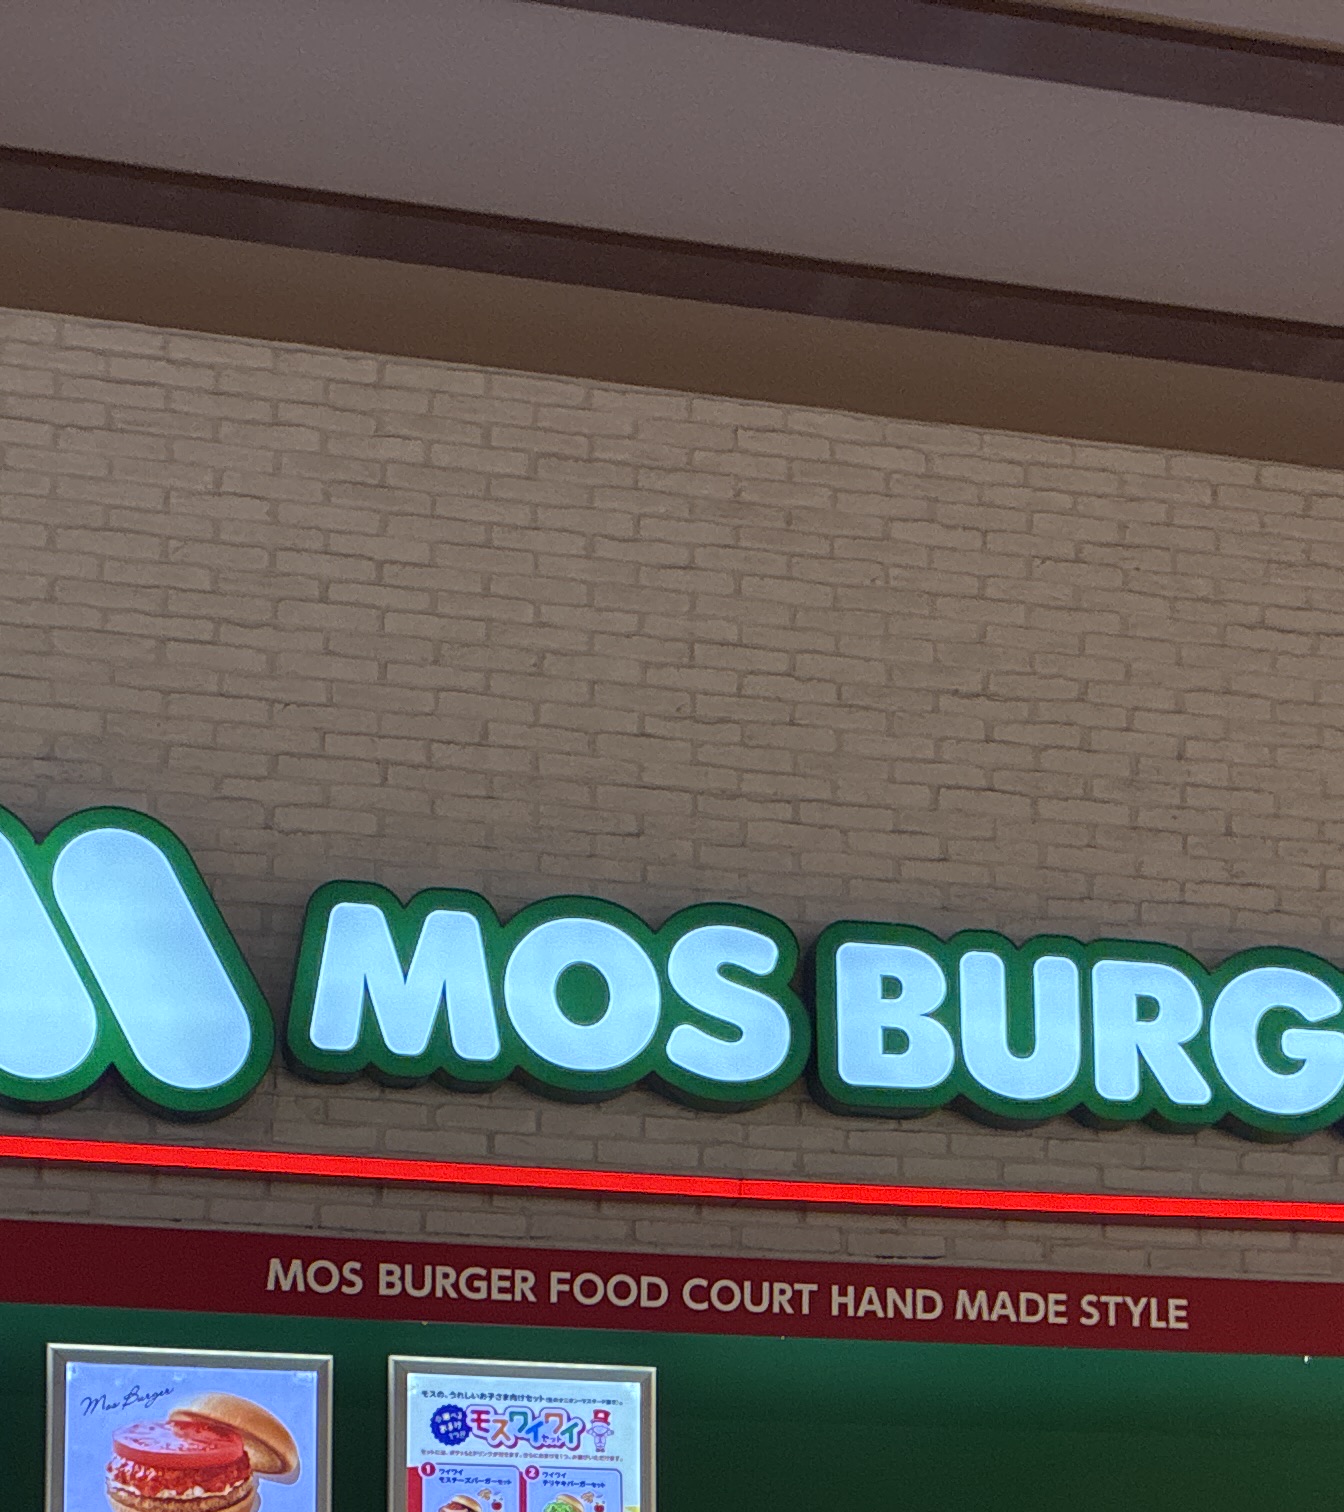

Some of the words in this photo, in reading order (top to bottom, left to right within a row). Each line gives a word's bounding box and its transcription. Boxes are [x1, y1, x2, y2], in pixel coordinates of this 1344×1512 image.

[309, 902, 791, 1083] MOS
[265, 1257, 363, 1295] MOS
[378, 1262, 538, 1303] BURGER
[550, 1270, 669, 1309] FOOD
[682, 1276, 819, 1315] COURT
[830, 1284, 945, 1322] HAND
[954, 1288, 1069, 1326] MADE
[1079, 1293, 1190, 1331] STYLE
[470, 1409, 579, 1444] モスワイワイ
